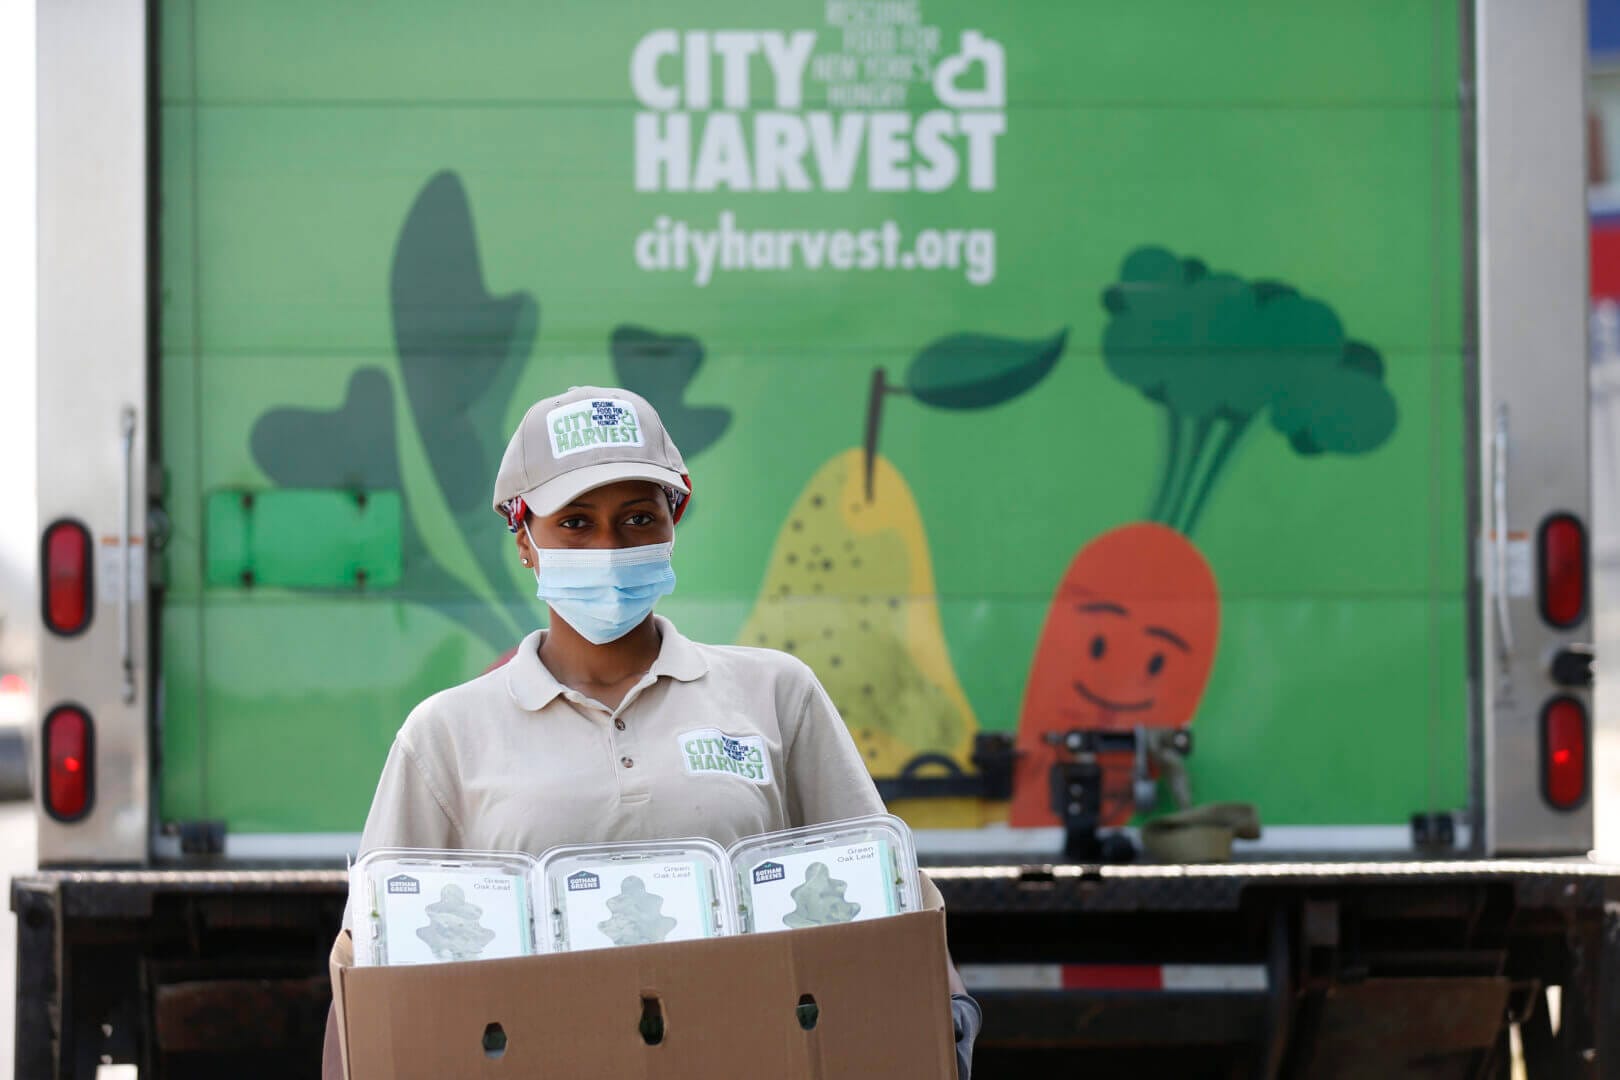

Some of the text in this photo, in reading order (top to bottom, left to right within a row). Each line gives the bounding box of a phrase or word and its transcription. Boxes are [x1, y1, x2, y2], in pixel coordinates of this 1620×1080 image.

[629, 28, 818, 110] CITY
[634, 111, 1007, 193] HARVEST
[634, 209, 997, 288] cityharvest.org
[553, 410, 593, 435] CITY
[556, 426, 638, 453] HARVEST
[684, 738, 724, 755] CITY
[688, 754, 764, 779] HARVEST
[570, 876, 597, 884] GOTHAM
[570, 881, 598, 889] GREENS
[756, 872, 783, 882] GREENS
